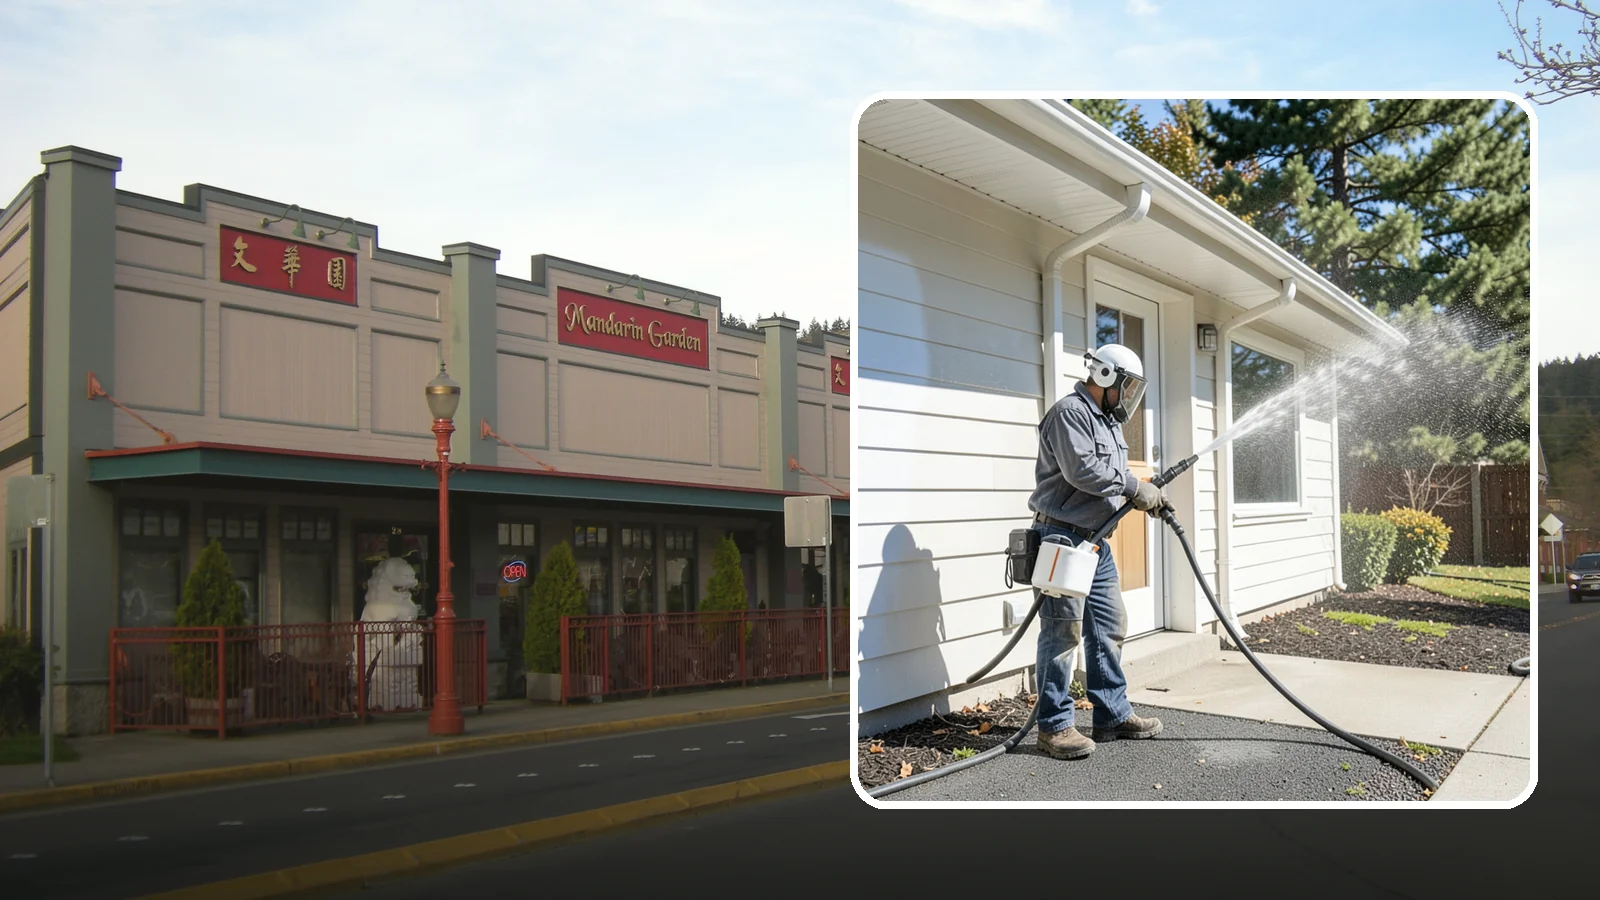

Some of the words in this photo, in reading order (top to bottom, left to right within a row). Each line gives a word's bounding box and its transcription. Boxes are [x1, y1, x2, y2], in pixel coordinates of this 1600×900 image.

[231, 235, 346, 291] 文華園
[564, 302, 643, 342] Mandarin
[648, 320, 701, 352] Garden
[503, 565, 527, 578] OPEN
